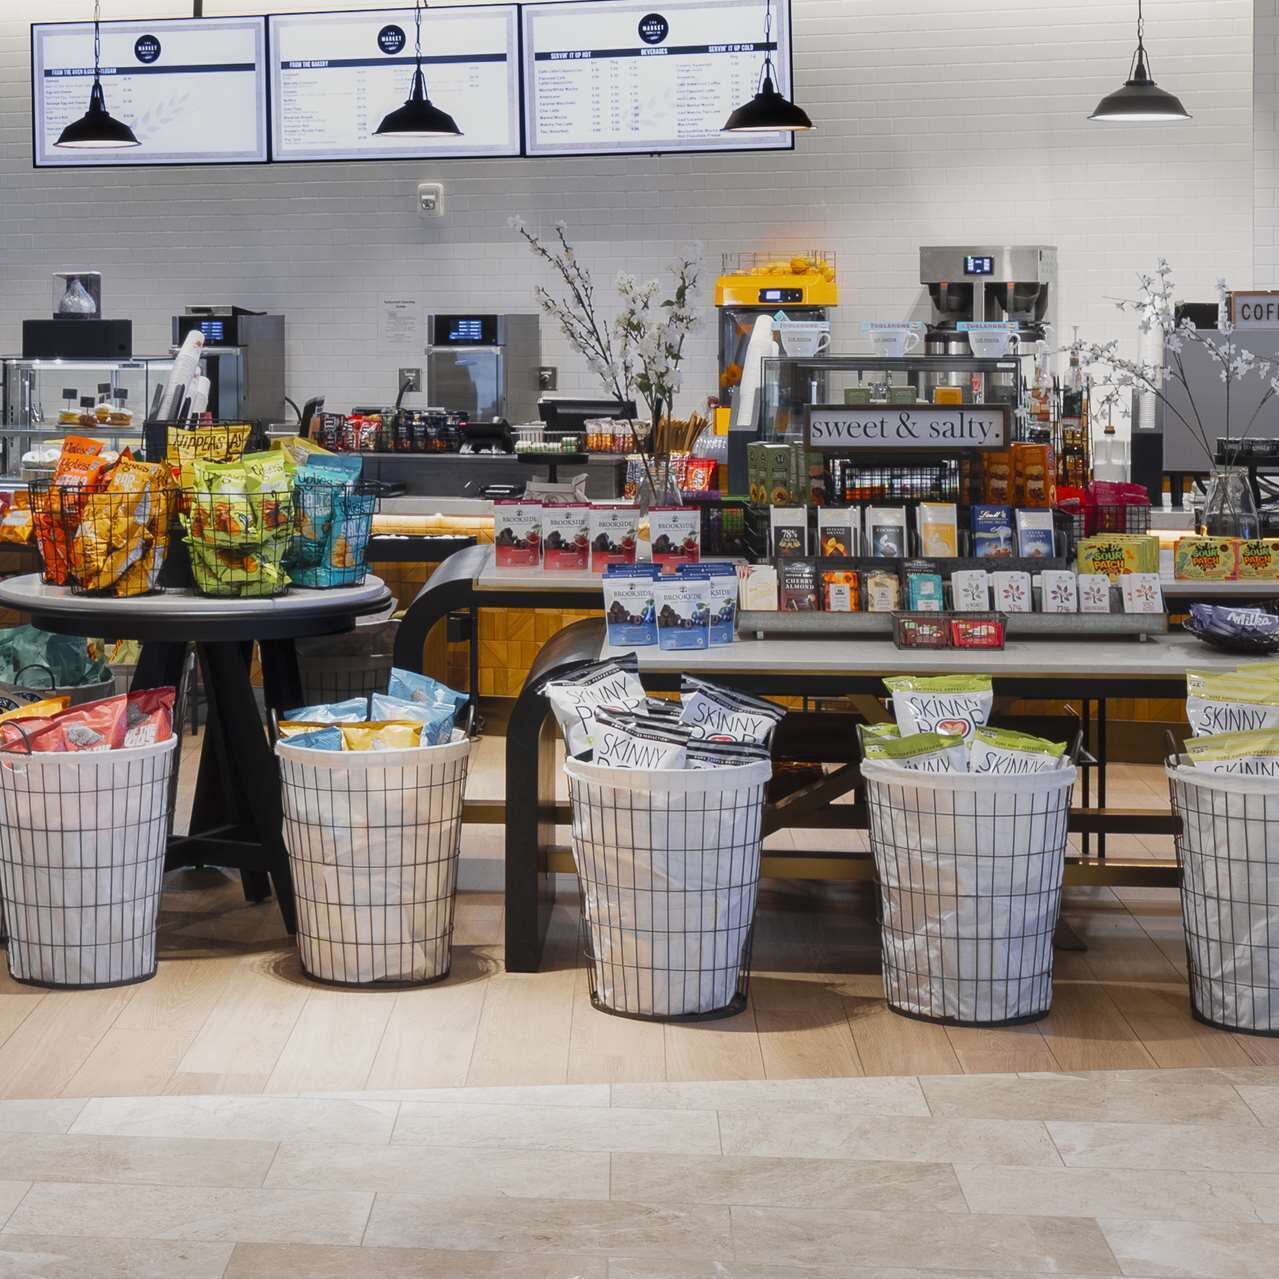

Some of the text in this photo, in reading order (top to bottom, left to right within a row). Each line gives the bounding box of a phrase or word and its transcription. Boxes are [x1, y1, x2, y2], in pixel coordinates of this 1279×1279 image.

[812, 412, 1000, 444] sweet & salty.
[174, 433, 225, 449] HIPPEAS
[1092, 560, 1126, 570] PATCH
[1093, 551, 1125, 560] SOUR
[1227, 612, 1272, 627] Milka
[566, 677, 631, 705] SKINNY
[694, 702, 762, 735] SKINNY
[910, 696, 980, 718] SKINNY
[1200, 703, 1267, 731] SKINNY
[599, 733, 668, 769] SKINNY
[979, 751, 1046, 774] SKINNY
